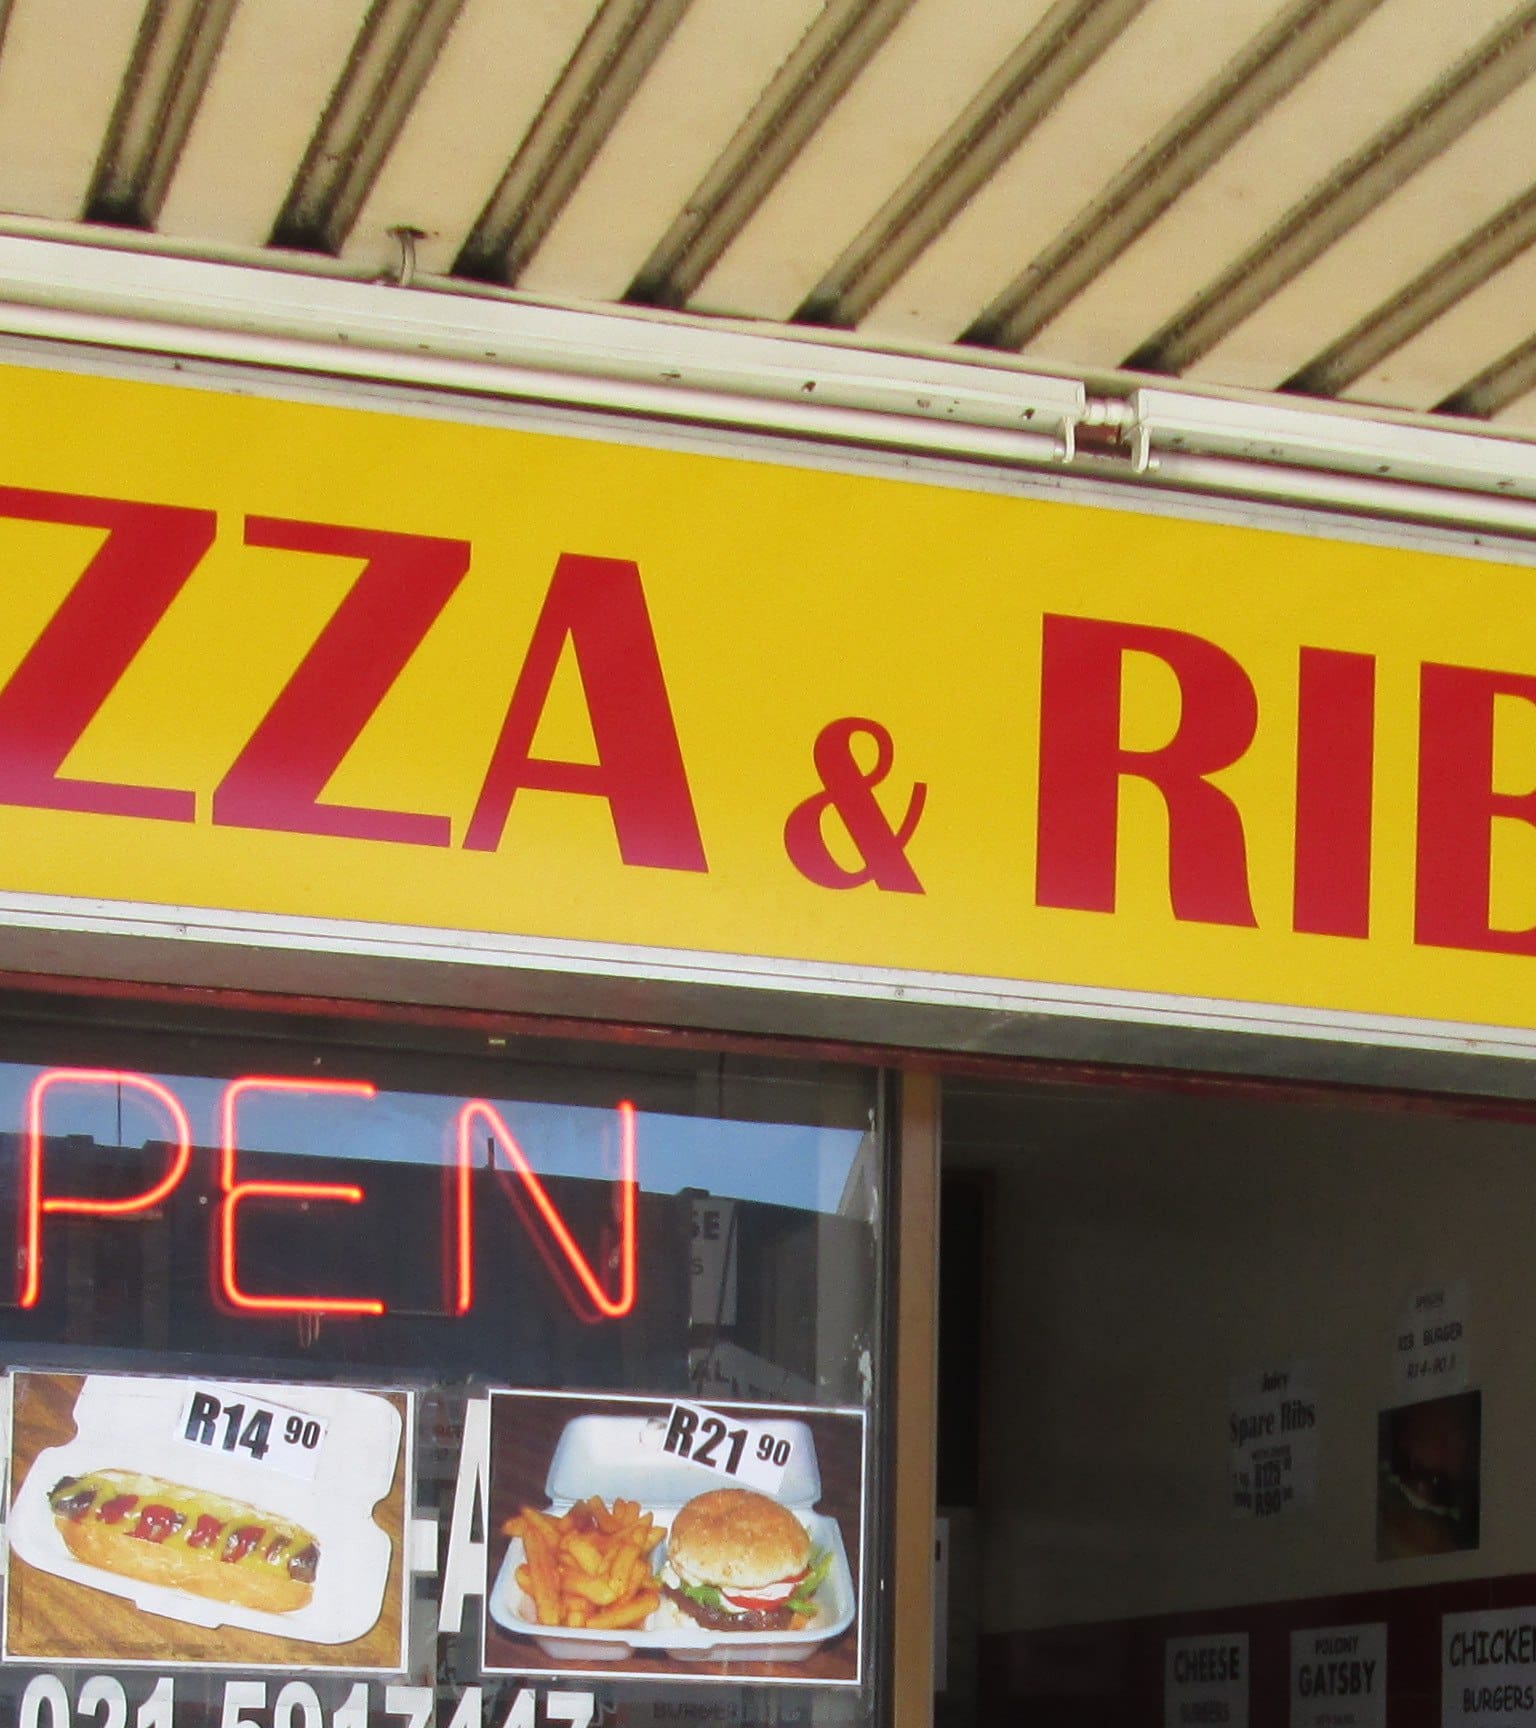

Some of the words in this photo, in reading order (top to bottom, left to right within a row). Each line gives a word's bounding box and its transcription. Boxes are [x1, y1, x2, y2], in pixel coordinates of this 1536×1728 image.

[781, 715, 927, 896] &
[1173, 1646, 1240, 1685] CHEESE
[1298, 1659, 1376, 1698] GATSBY
[1462, 1684, 1535, 1715] BURGERS
